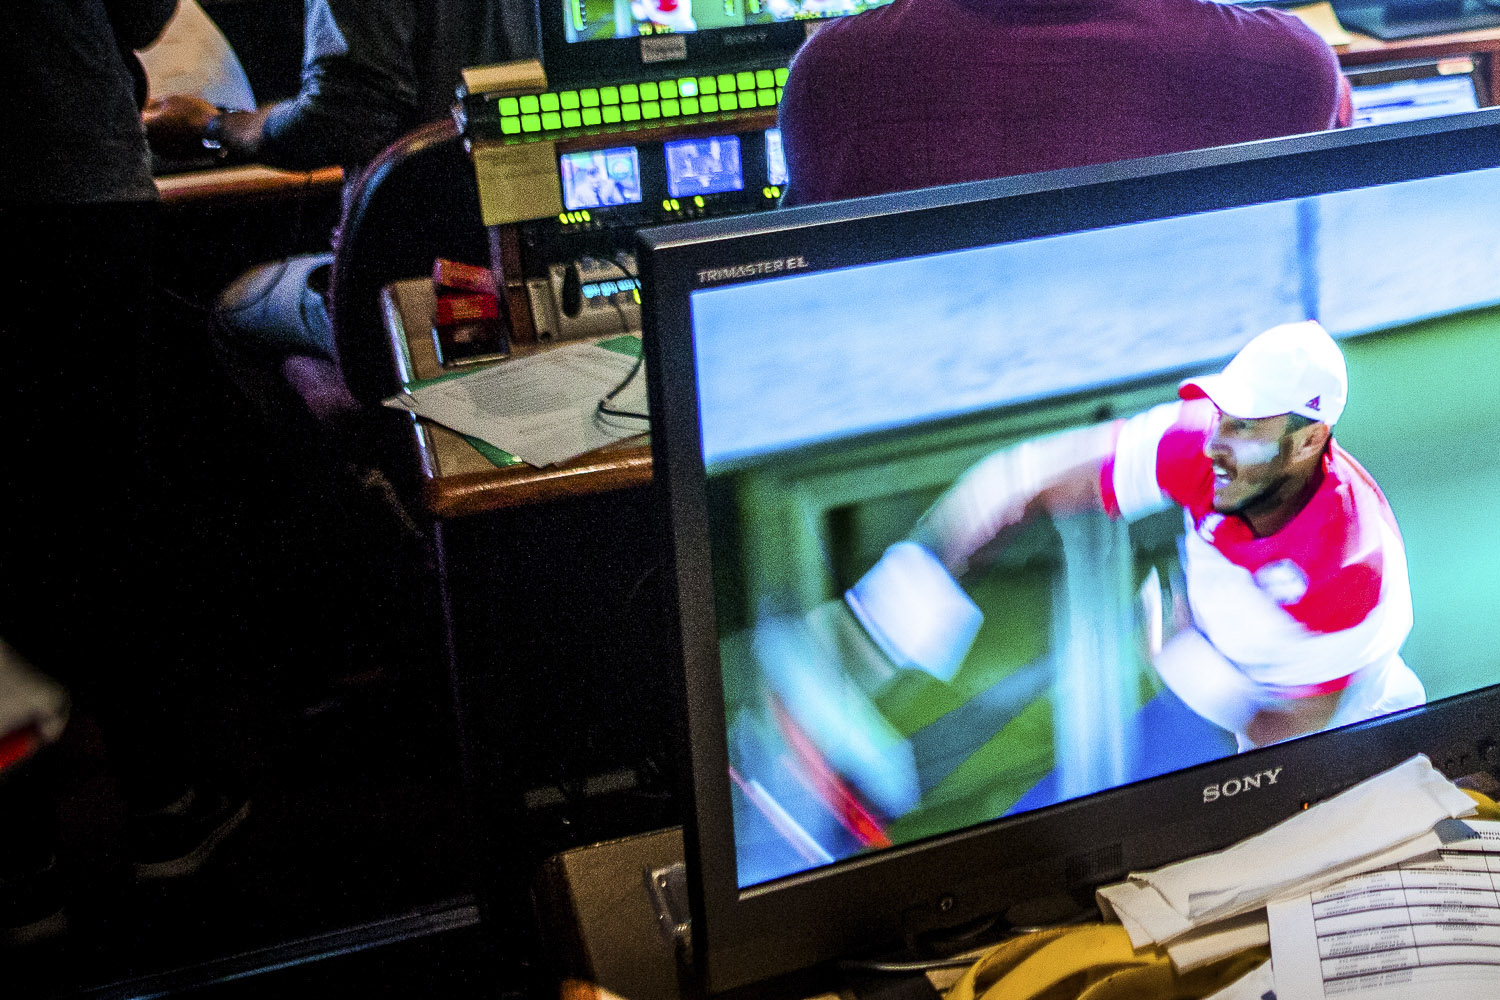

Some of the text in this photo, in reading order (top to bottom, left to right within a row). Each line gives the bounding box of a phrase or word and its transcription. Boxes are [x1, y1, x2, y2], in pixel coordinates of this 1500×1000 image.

[697, 256, 808, 282] TRIMASTER EL
[1203, 768, 1283, 804] SONY
